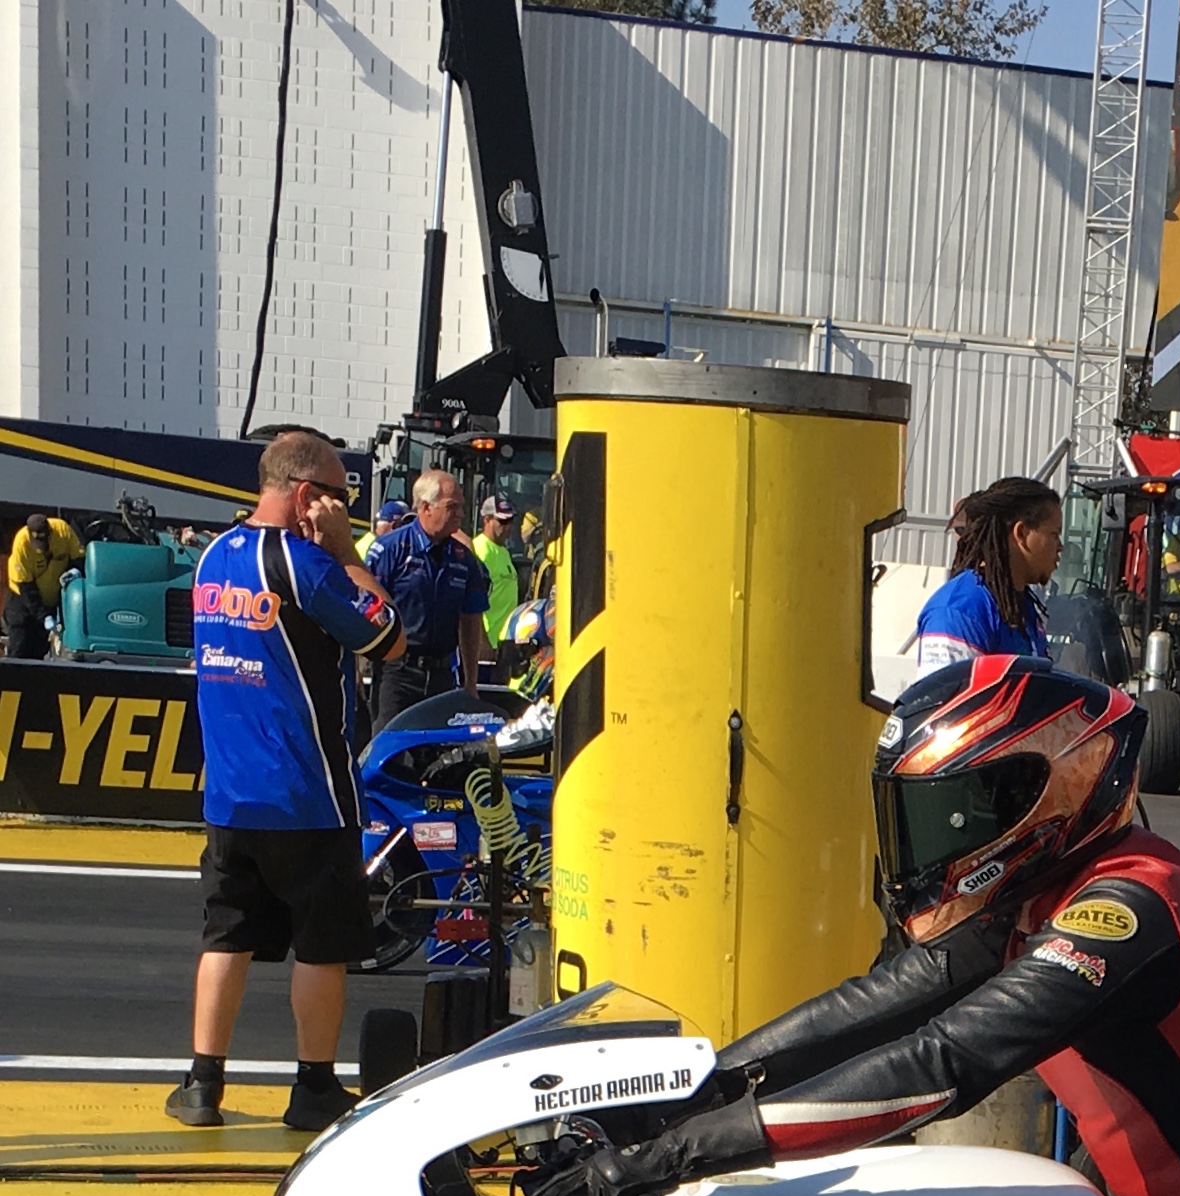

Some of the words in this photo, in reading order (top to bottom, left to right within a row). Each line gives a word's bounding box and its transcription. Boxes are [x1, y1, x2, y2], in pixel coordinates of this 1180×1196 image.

[964, 864, 1001, 892] SHOEI
[1061, 909, 1130, 930] BATES
[535, 1083, 603, 1112] HECTOR
[607, 1072, 665, 1099] ARANA
[669, 1068, 692, 1090] JR
